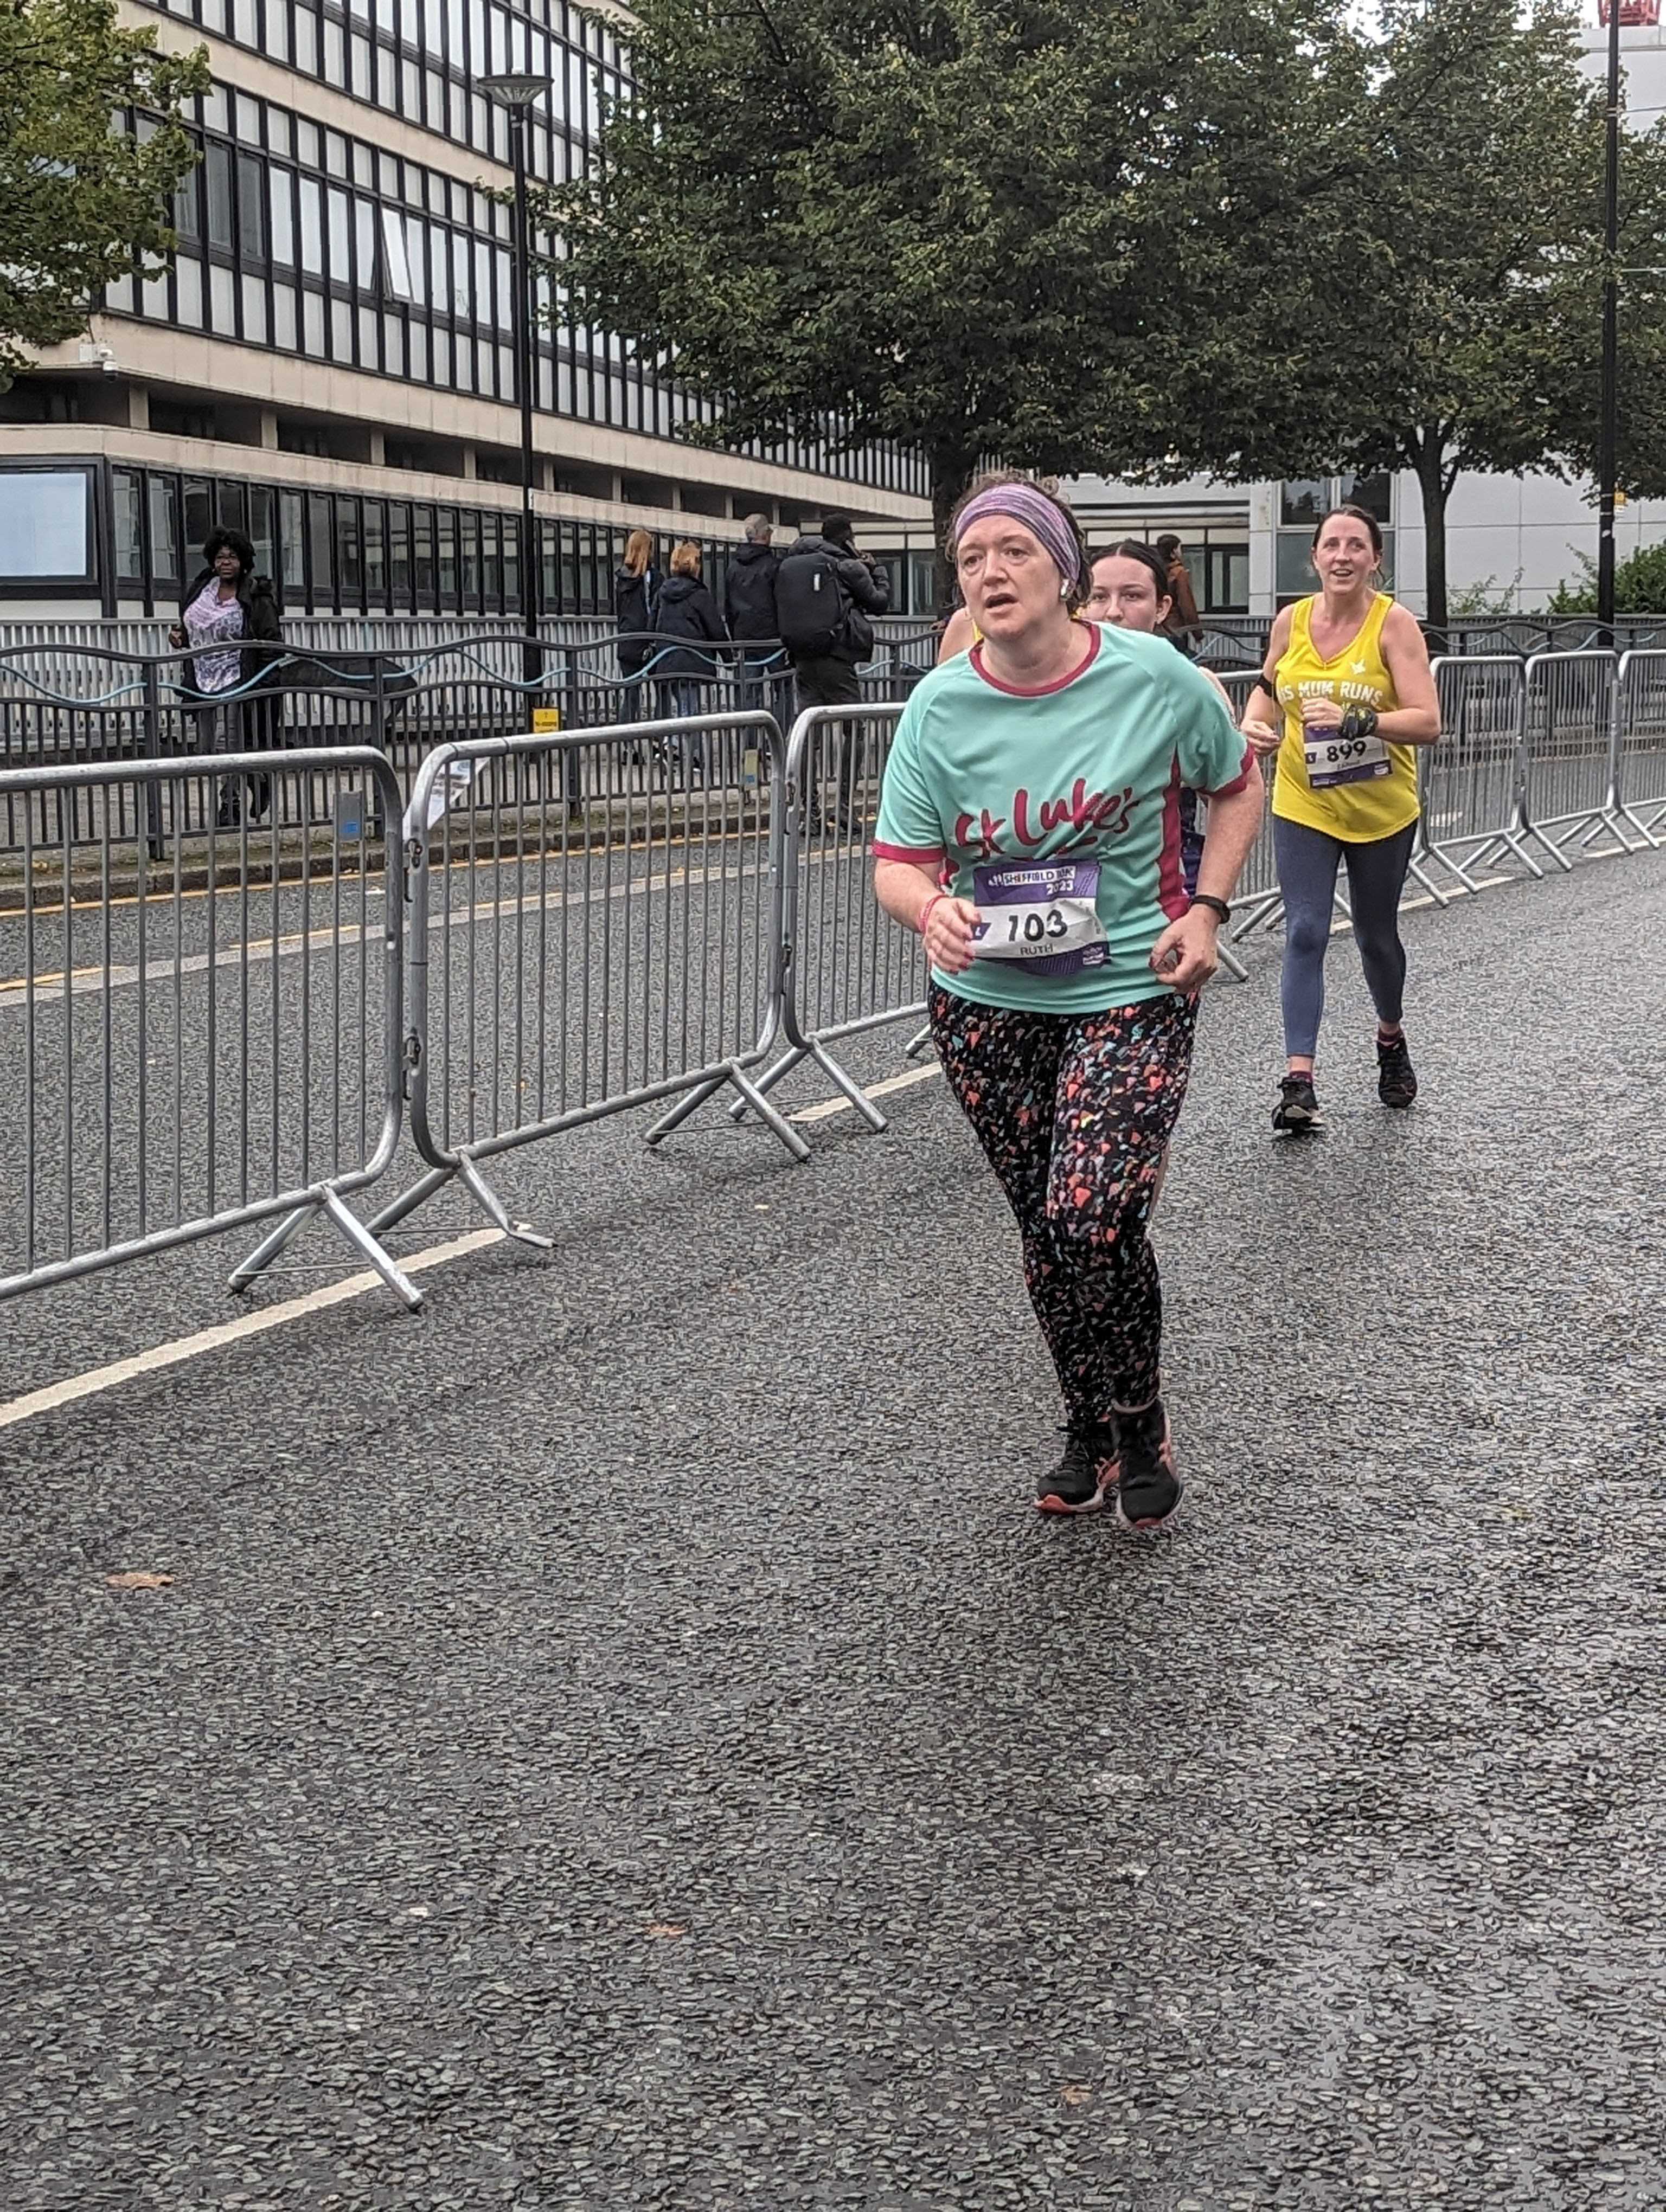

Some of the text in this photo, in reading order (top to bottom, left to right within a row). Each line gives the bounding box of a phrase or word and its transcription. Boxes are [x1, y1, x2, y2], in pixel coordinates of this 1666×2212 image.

[1340, 681, 1383, 710] RUNS
[1327, 741, 1367, 762] 899
[1013, 777, 1143, 846] Luke's
[1046, 880, 1074, 895] 2023
[1008, 909, 1068, 942] 103
[1020, 943, 1053, 956] RUTH
